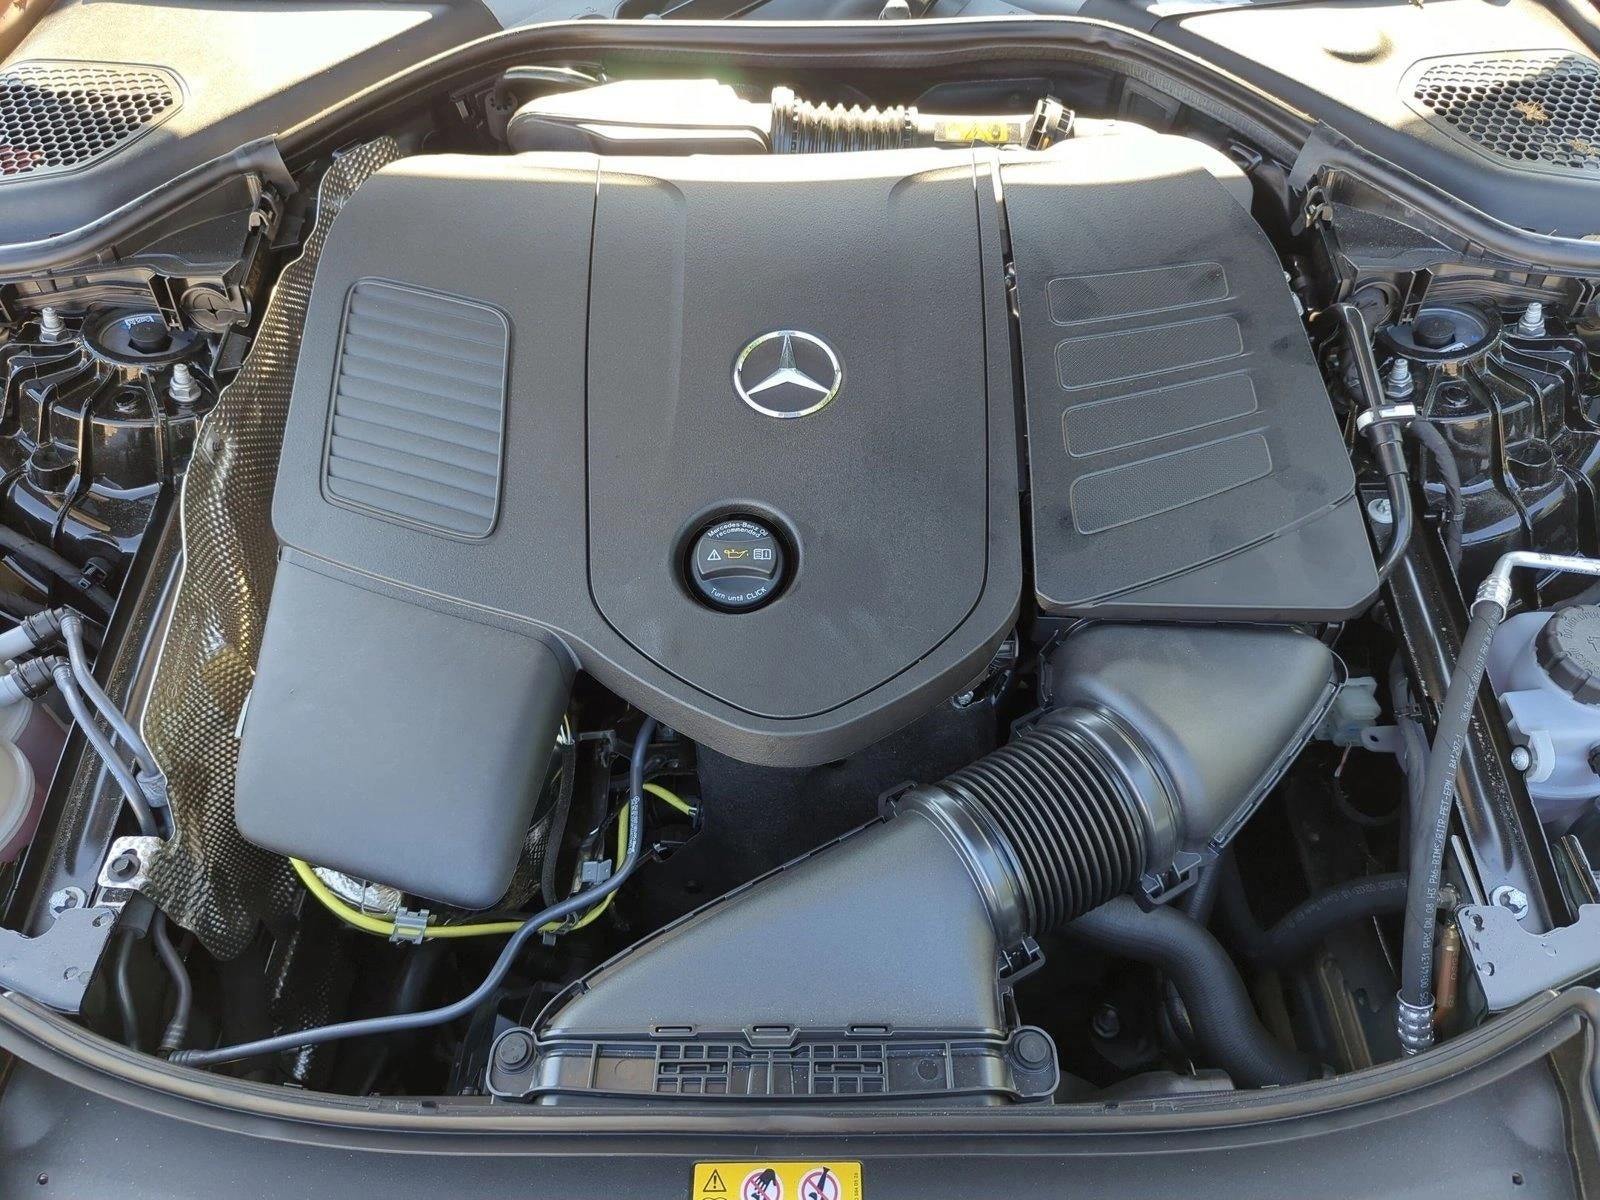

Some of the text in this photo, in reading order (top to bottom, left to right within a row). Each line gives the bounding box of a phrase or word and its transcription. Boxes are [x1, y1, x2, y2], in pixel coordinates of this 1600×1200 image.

[707, 522, 759, 538] Mercedes-Benz
[716, 528, 761, 538] recommended
[710, 587, 726, 600] Turn
[746, 586, 767, 600] CLICK
